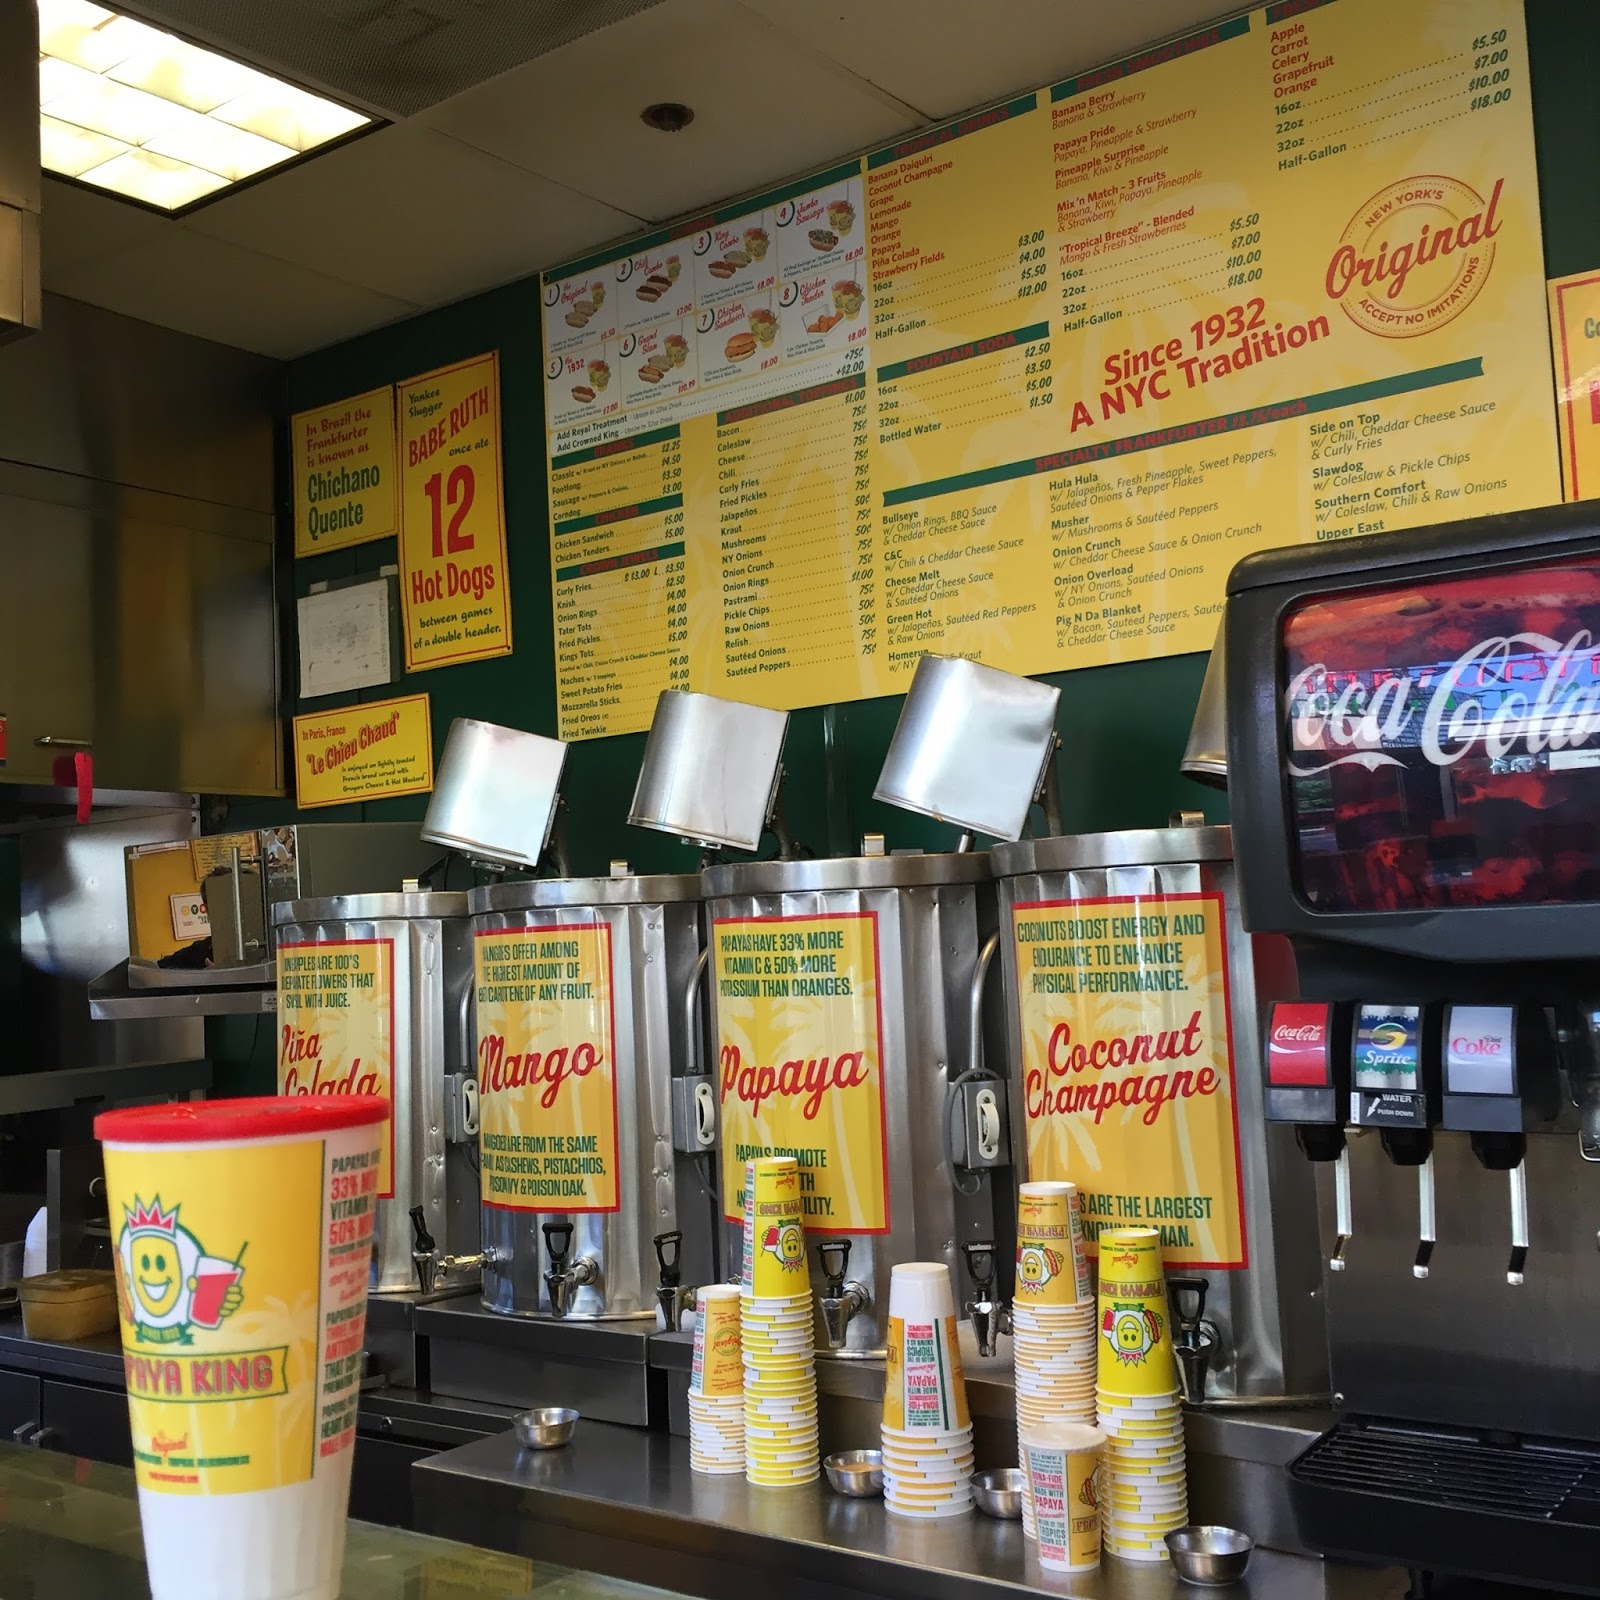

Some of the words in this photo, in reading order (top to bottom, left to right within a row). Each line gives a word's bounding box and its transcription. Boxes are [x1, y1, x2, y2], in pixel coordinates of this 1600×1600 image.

[1270, 23, 1305, 43] Apple
[1271, 35, 1309, 57] Carrot
[1272, 50, 1310, 71] Celery
[1272, 55, 1335, 85] Grapefruit
[1273, 77, 1318, 99] Orange
[1051, 102, 1087, 120] Banana
[1088, 90, 1116, 107] Berry
[1470, 87, 1512, 112] $18.00
[1053, 135, 1088, 153] Papaya
[1089, 125, 1116, 141] Pride
[1055, 158, 1102, 180] Pineapple
[1103, 142, 1146, 164] Surprise
[1278, 143, 1347, 171] Half-Gallon
[868, 168, 898, 185] Banana
[868, 176, 902, 196] Coconut
[904, 160, 953, 184] Champagne
[869, 194, 894, 209] Grape
[870, 200, 912, 220] Lemonade
[1364, 201, 1393, 228] NEW
[1395, 189, 1444, 205] YORK'S
[870, 218, 899, 233] Mango
[870, 229, 901, 244] Orange
[871, 241, 901, 257] Papaya
[1325, 177, 1505, 299] Original
[872, 260, 918, 281] Strawberry
[920, 251, 945, 267] Fields
[891, 247, 920, 263] Colada
[1020, 263, 1047, 280] $5.50
[872, 281, 893, 293] 16oz
[1017, 280, 1048, 299] $12.00
[1358, 298, 1403, 325] ACCEPT
[1405, 313, 1425, 325] NO
[1427, 256, 1480, 319] IMITATIONS
[1103, 338, 1183, 386] Since
[1190, 297, 1266, 351] 1932
[1069, 401, 1095, 433] A
[1099, 369, 1172, 421] NYC
[1177, 315, 1331, 389] Tradition
[408, 388, 441, 404] Yankee
[408, 401, 443, 419] Slugger
[306, 423, 318, 437] In
[320, 412, 351, 433] Brazil
[354, 408, 372, 423] the
[408, 418, 447, 467] BABE
[450, 386, 489, 438] RUTH
[556, 431, 571, 441] Add
[572, 424, 591, 437] Royal
[592, 414, 628, 431] Treatment
[717, 426, 740, 439] Bacon
[1309, 421, 1335, 435] Side
[1339, 420, 1354, 430] on
[1357, 413, 1381, 426] Top
[306, 426, 369, 453] Frankfurter
[449, 445, 472, 457] once
[475, 438, 489, 449] ate
[1034, 443, 1112, 471] SPECIALTY
[1115, 417, 1227, 453] FRANKFURTER
[306, 455, 315, 468] is
[318, 447, 354, 465] known
[357, 442, 370, 453] as
[1312, 461, 1364, 479] Slawdog
[1333, 469, 1384, 488] Coleslaw
[1387, 465, 1397, 476] &
[1400, 459, 1434, 475] Pickle
[1437, 451, 1471, 468] Chips
[307, 464, 380, 504] Chichano
[1314, 491, 1370, 510] Southern
[1374, 479, 1426, 499] Comfort
[308, 501, 364, 541] Quente
[424, 464, 475, 558] 12
[882, 510, 919, 525] Bullseye
[1067, 522, 1123, 540] Mushrooms
[1125, 517, 1133, 528] &
[1136, 509, 1176, 526] Sautéed
[1178, 501, 1219, 518] Peppers
[1316, 526, 1354, 541] Upper
[1357, 519, 1385, 532] East
[721, 534, 767, 551] Mushrooms
[884, 549, 903, 562] C&C
[411, 569, 443, 605] Hot
[446, 563, 495, 601] Dogs
[885, 575, 917, 588] Cheese
[919, 569, 940, 582] Melt
[557, 599, 576, 610] Knish
[723, 592, 758, 607] Pastrami
[419, 613, 458, 629] between
[461, 607, 493, 623] games
[413, 637, 423, 649] of
[424, 638, 430, 647] a
[431, 630, 462, 645] double
[464, 624, 502, 638] header.
[326, 726, 347, 737] France
[1068, 918, 1109, 941] BOOST
[1112, 914, 1169, 938] ENERGY
[1173, 913, 1205, 936] AND
[512, 943, 537, 961] OFFER
[540, 940, 579, 959] AMONG
[752, 933, 778, 952] HAVE
[779, 932, 804, 952] 33%
[807, 930, 844, 949] MORE
[334, 954, 360, 969] 100'S
[774, 955, 798, 974] 50%
[800, 954, 837, 973] MORE
[1095, 944, 1111, 966] TO
[350, 972, 375, 989] THAT
[522, 962, 564, 980] AMOUNT
[566, 962, 580, 979] OF
[1032, 972, 1077, 994] PHYSICAL
[1079, 969, 1189, 994] PERFORMANCE.
[538, 984, 559, 1001] ANY
[560, 982, 594, 1000] FRUIT.
[763, 979, 789, 997] THAN
[792, 977, 854, 997] ORANGES.
[304, 993, 323, 1008] WITH
[324, 992, 351, 1008] JUICE.
[281, 1024, 323, 1067] Piña
[1048, 1010, 1203, 1077] Coconut
[1451, 1036, 1502, 1057] Coke
[1362, 1050, 1412, 1067] Sprite
[479, 1034, 604, 1109] Mango
[720, 1044, 869, 1120] Papaya
[1026, 1066, 1221, 1126] Champagne
[1382, 1093, 1413, 1104] WATER
[1394, 1109, 1415, 1118] DOWN
[522, 1136, 546, 1153] FROM
[548, 1136, 565, 1153] THE
[566, 1135, 598, 1153] SAME
[543, 1157, 606, 1176] PISTACHIOS,
[527, 1179, 561, 1197] POISON
[562, 1179, 587, 1197] OAK.
[1088, 1195, 1114, 1217] ARE
[1115, 1195, 1143, 1218] THE
[1145, 1196, 1213, 1219] LARGEST
[906, 1346, 935, 1357] TROPICS
[191, 1355, 273, 1397] KING
[907, 1375, 938, 1387] PAPAYA
[1035, 1496, 1064, 1511] PAPAYA
